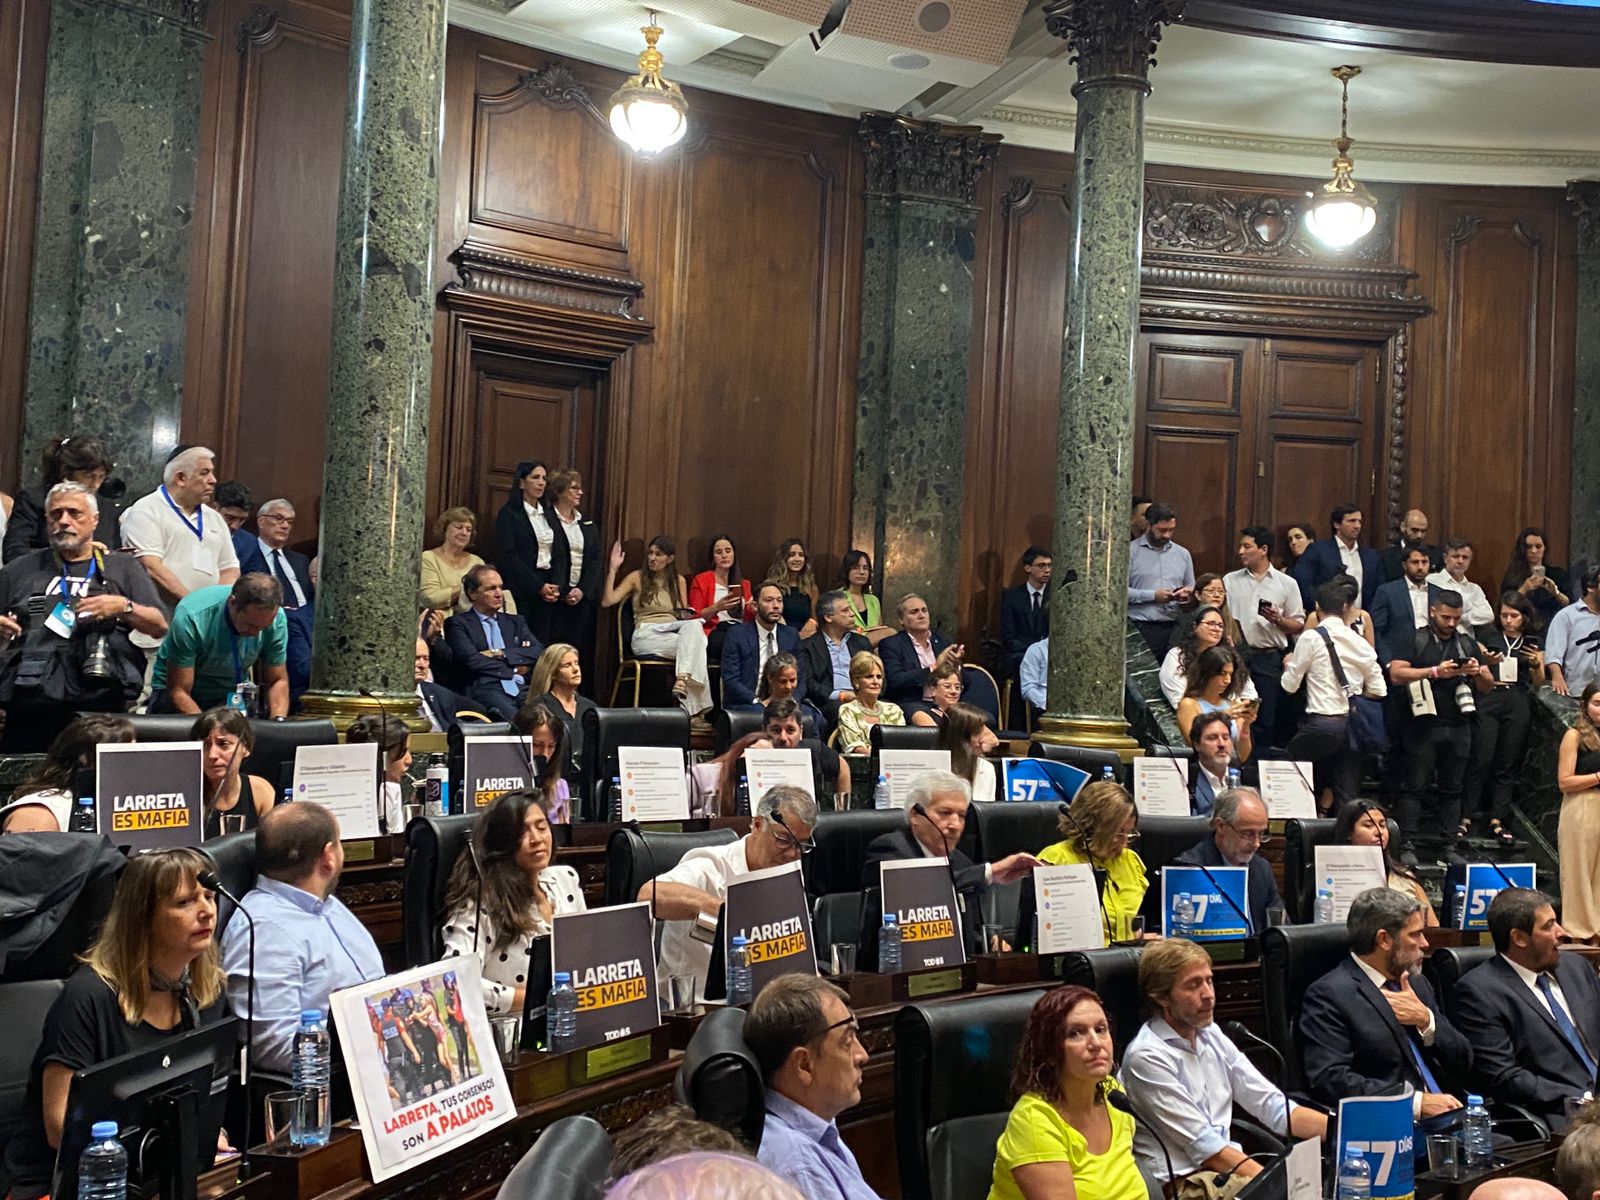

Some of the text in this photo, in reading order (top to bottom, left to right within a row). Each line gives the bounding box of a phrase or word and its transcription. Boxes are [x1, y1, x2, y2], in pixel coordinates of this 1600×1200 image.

[476, 777, 524, 791] LARRETA
[1012, 779, 1038, 801] 57
[114, 793, 186, 812] LARRETA
[476, 793, 490, 804] ES
[114, 810, 188, 829] ES MAFIA
[898, 905, 951, 924] LARRETA
[900, 922, 954, 940] ES MAFIA
[766, 934, 806, 958] MAFIA
[572, 958, 643, 988] LARRETA
[576, 980, 646, 1008] ES MAFIA
[384, 1078, 495, 1134] LARRETA, TUS CONSENSOS
[402, 1132, 424, 1150] SON
[426, 1122, 440, 1140] A
[1398, 1135, 1413, 1154] DÍAS
